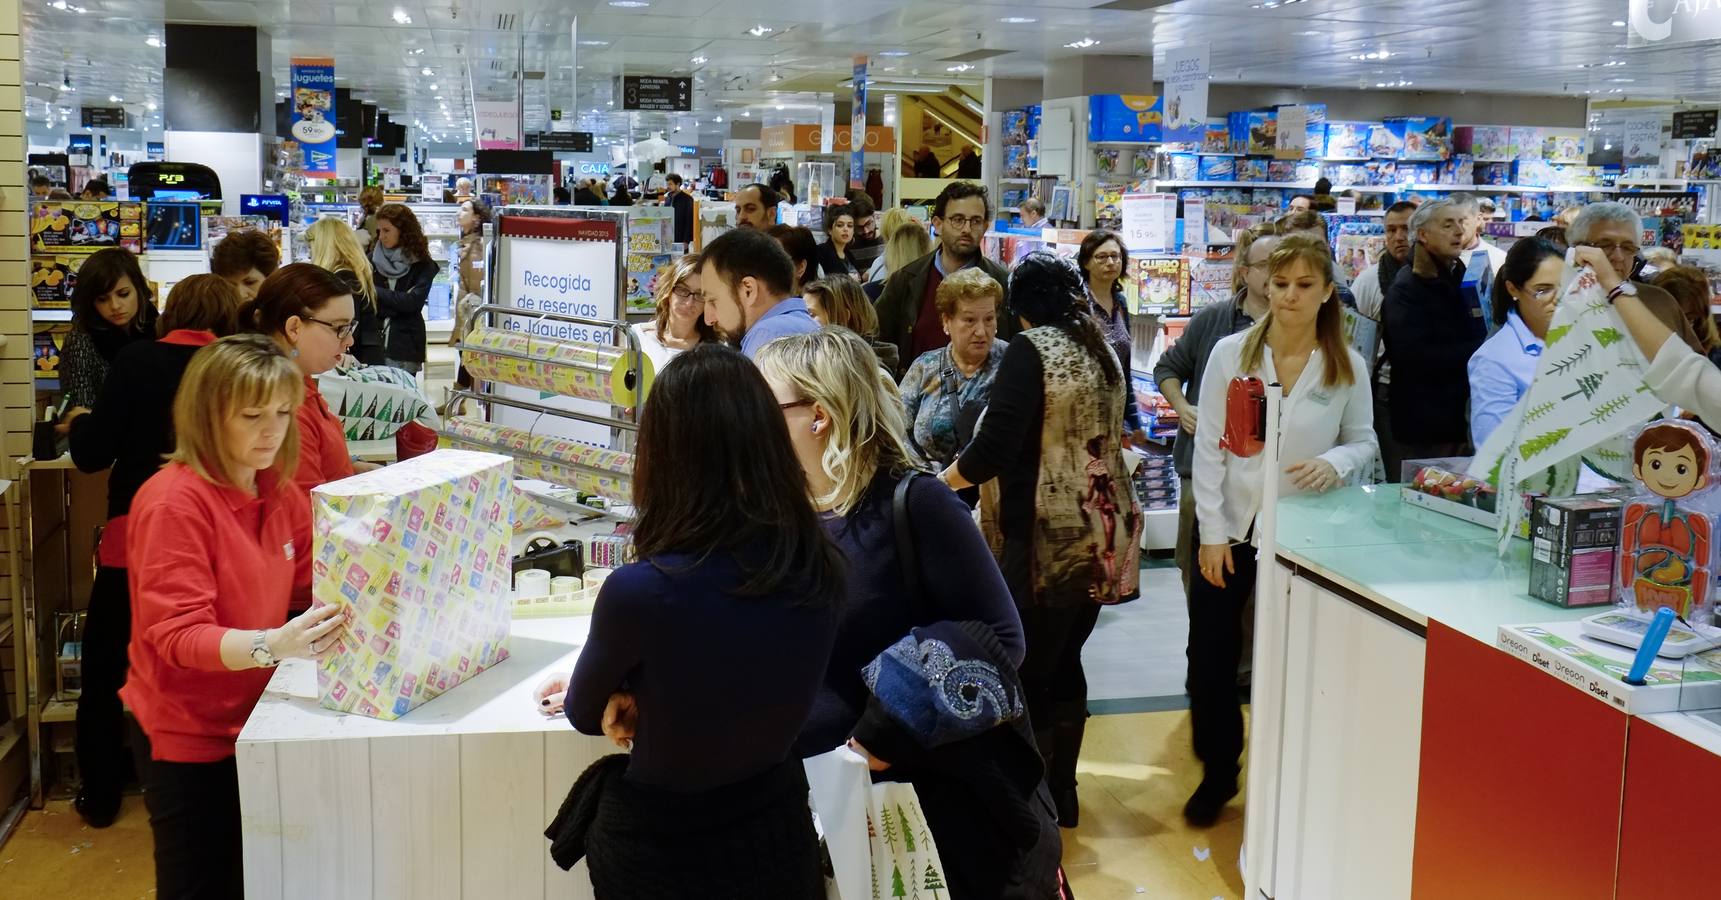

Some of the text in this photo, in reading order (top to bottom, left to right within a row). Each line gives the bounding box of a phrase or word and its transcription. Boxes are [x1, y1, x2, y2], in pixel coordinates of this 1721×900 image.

[292, 73, 333, 84] Juguetes
[628, 88, 637, 103] 3
[580, 163, 609, 174] CAJA
[159, 174, 184, 183] PS3
[1617, 196, 1677, 210] SCALEXTRIC
[524, 270, 591, 294] Recogida
[517, 295, 597, 318] de reservas
[503, 317, 521, 331] de
[593, 328, 611, 344] en
[1500, 632, 1528, 654] Oregon
[1532, 652, 1550, 669] Diset
[1554, 660, 1585, 683] Oregon
[1589, 681, 1608, 699] Diset
